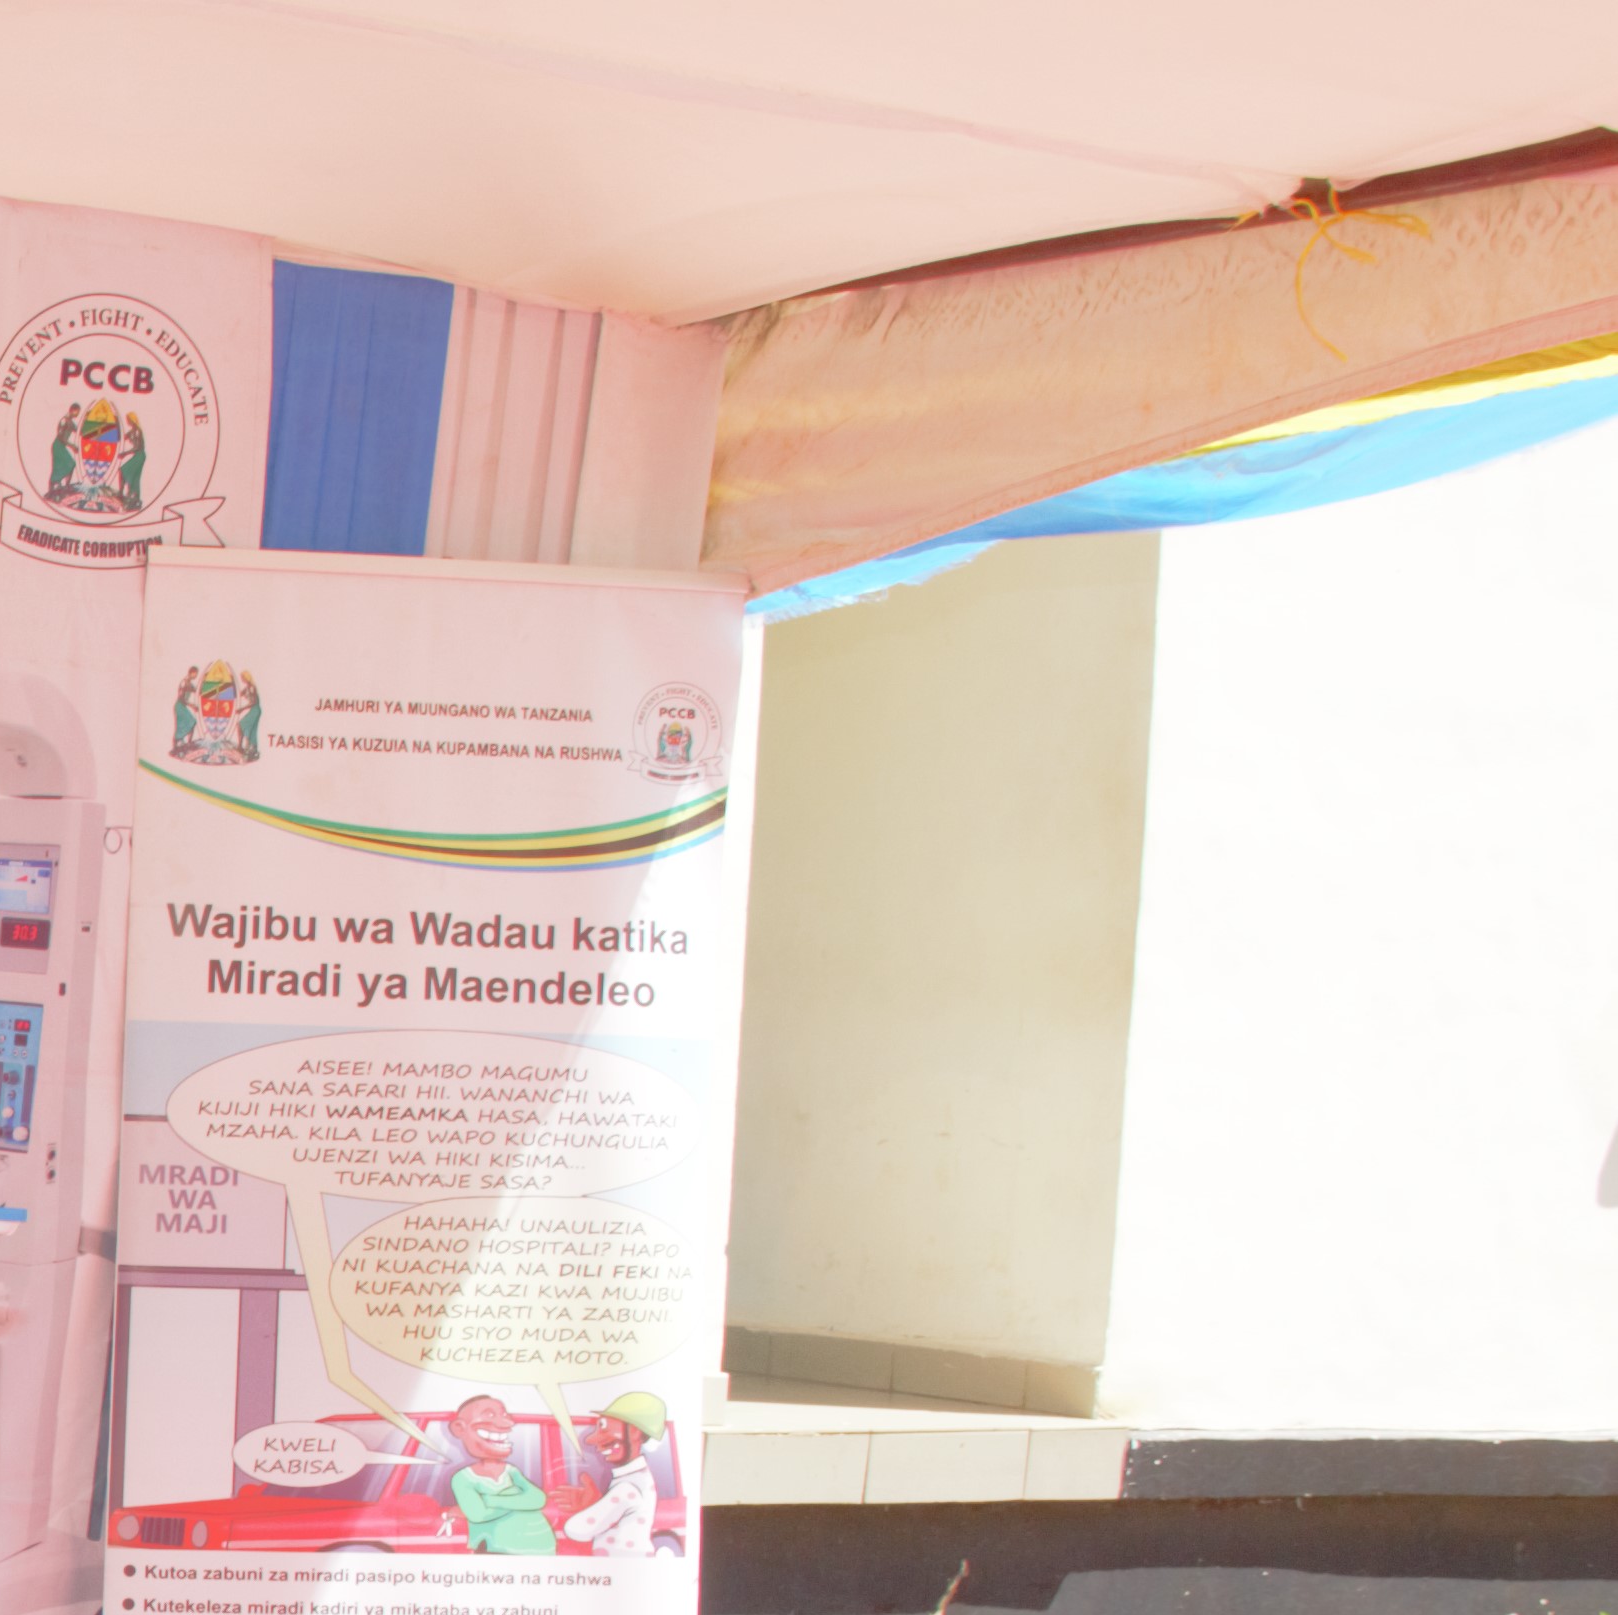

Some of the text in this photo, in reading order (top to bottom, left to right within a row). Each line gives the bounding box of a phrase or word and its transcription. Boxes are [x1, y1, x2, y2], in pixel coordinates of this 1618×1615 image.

[59, 358, 155, 394] PCCB
[79, 307, 145, 332] FIGHT
[154, 330, 210, 427] EDUCATE
[17, 524, 81, 556] ERADICATE
[314, 698, 593, 723] JAMHURI YA MUUNGANO WA TANZANIA
[658, 706, 696, 720] PCCB
[267, 734, 623, 762] TAASISI YA KUZUIA NA KUPAMBANA NA RUSHWA
[166, 902, 688, 955] Wajibu wa Wadau katika
[207, 959, 655, 1008] Miradi ya Maendeleo
[296, 1059, 589, 1083] AISEE! MAMBO MAGUMU
[248, 1080, 314, 1096] SANA
[322, 1082, 407, 1099] SAFARI
[459, 1087, 588, 1105] WANANCHI
[598, 1091, 635, 1105] WA
[198, 1100, 260, 1117] KIJIJI
[268, 1103, 316, 1118] HIKI
[325, 1104, 469, 1122] WAMEAMKA
[308, 1126, 362, 1142] KILA
[371, 1127, 419, 1144] LEO
[426, 1129, 496, 1146] WAPO
[504, 1132, 669, 1150] KUCHUNGULIA
[138, 1164, 240, 1187] MRADI
[334, 1170, 553, 1190] TUFANYAJE SASA?
[167, 1189, 218, 1210] WA
[155, 1213, 228, 1235] MAJI
[403, 1215, 647, 1235] HAHAHA! UNAULIZIA
[362, 1236, 680, 1259] SINDANO HOSPITALI? HAPO
[354, 1280, 465, 1297] KUFANYA
[474, 1283, 528, 1298] KAZI
[537, 1284, 592, 1300] KWA
[402, 1324, 639, 1344] HUU SIYO MUDA WA
[419, 1348, 545, 1366] KUCHEZEA
[263, 1438, 337, 1453] KWELI
[144, 1565, 612, 1588] Kutoa zabuni za miradi pasipo kugubikwa na rushwa
